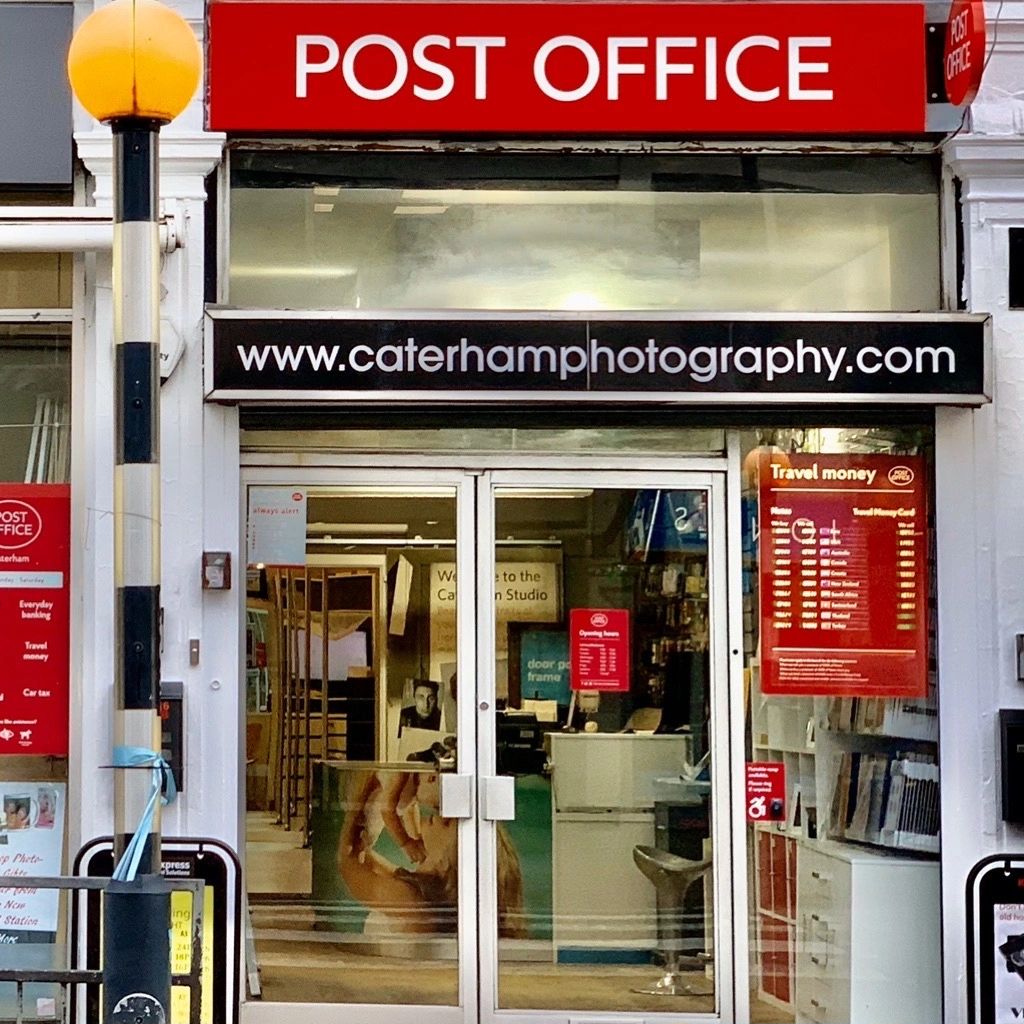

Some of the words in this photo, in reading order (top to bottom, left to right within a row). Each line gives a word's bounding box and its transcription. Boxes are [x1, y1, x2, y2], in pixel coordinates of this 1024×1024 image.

[951, 9, 969, 46] POST
[947, 40, 971, 80] OFFICE
[296, 34, 506, 100] POST
[534, 36, 833, 101] OFFICE
[236, 337, 956, 383] www.caterhamphotography.com
[770, 463, 819, 480] Travel
[822, 468, 877, 485] money
[503, 571, 516, 582] to
[520, 569, 541, 582] the
[506, 588, 548, 600] Studio
[19, 600, 53, 610] Everyday
[21, 610, 51, 620] banking
[24, 641, 48, 650] Travel
[23, 654, 49, 662] money
[527, 659, 555, 670] door
[527, 672, 561, 682] frame
[23, 688, 37, 697] Car
[38, 688, 51, 697] tax
[3, 900, 26, 910] New
[4, 914, 39, 926] Station
